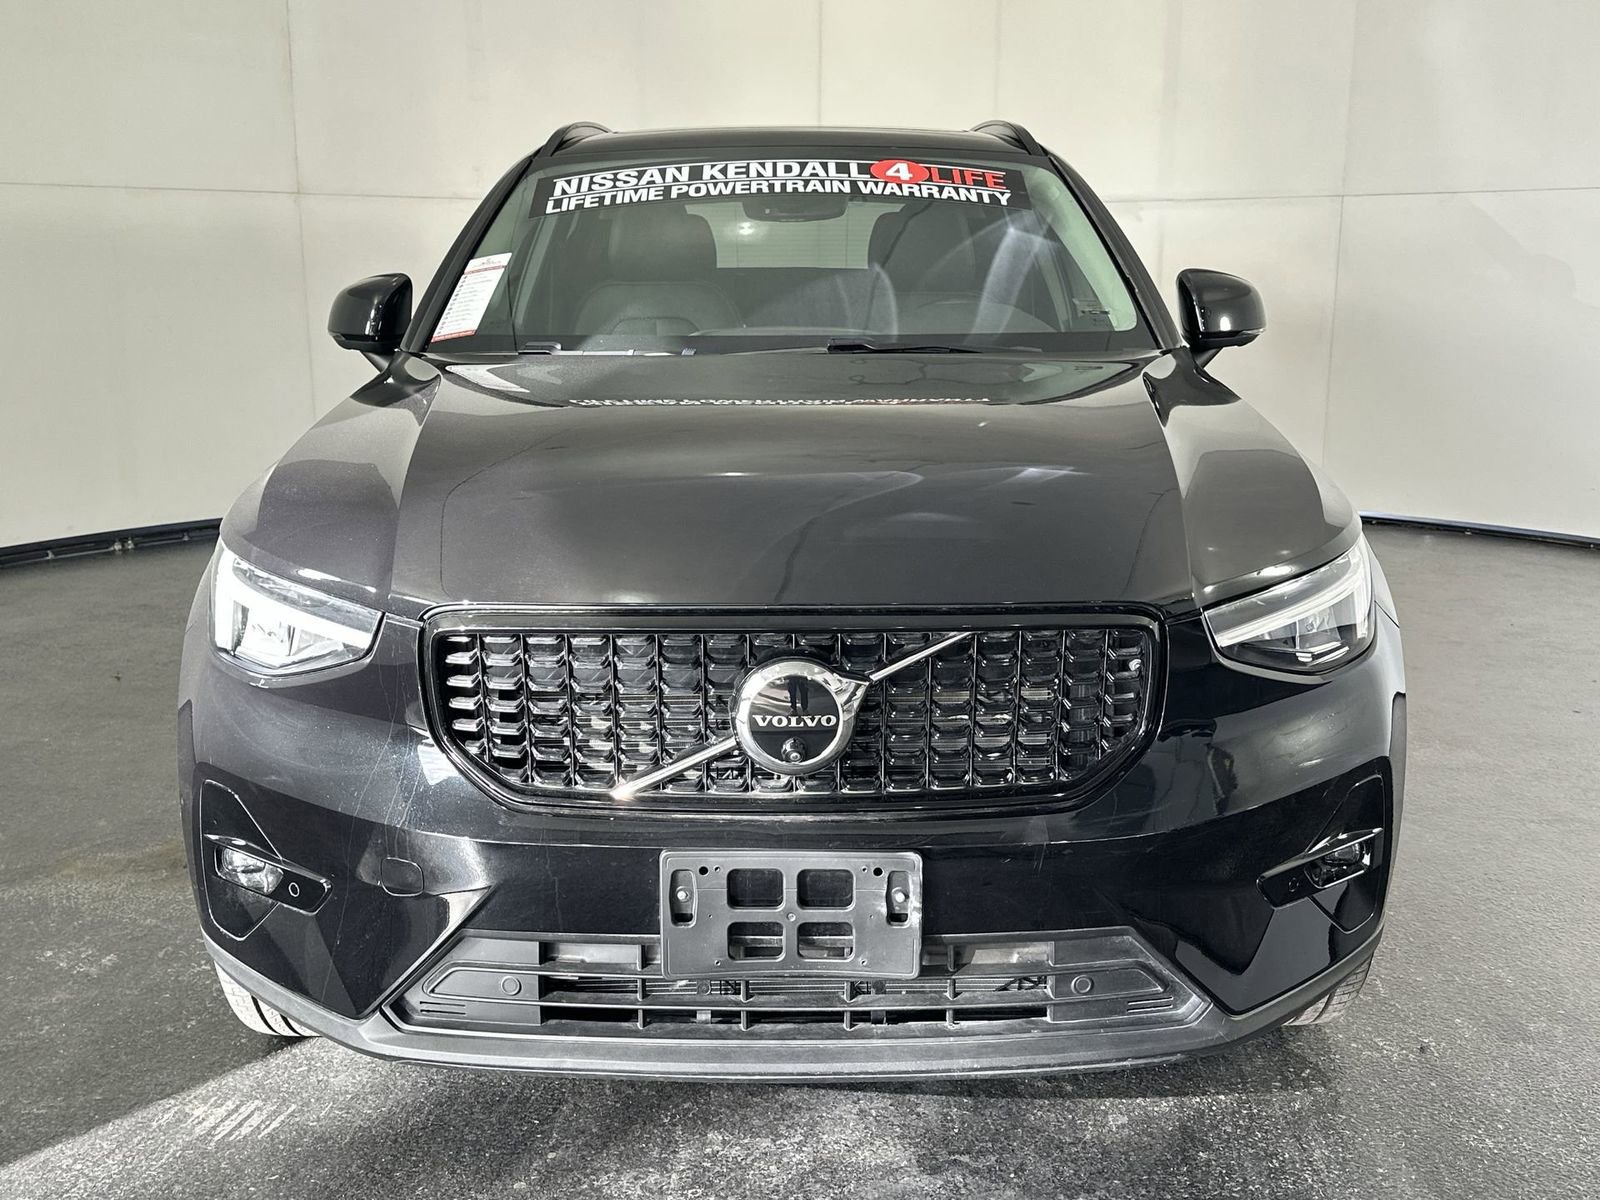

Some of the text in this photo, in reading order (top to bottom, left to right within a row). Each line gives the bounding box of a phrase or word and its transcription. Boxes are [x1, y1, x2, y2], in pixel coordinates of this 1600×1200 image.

[545, 179, 1011, 214] LIFETIME POWERTRAIN WARRANTY
[553, 161, 1006, 197] NISSAN KENDALL 4 LIFE
[752, 714, 837, 728] VOLVO
